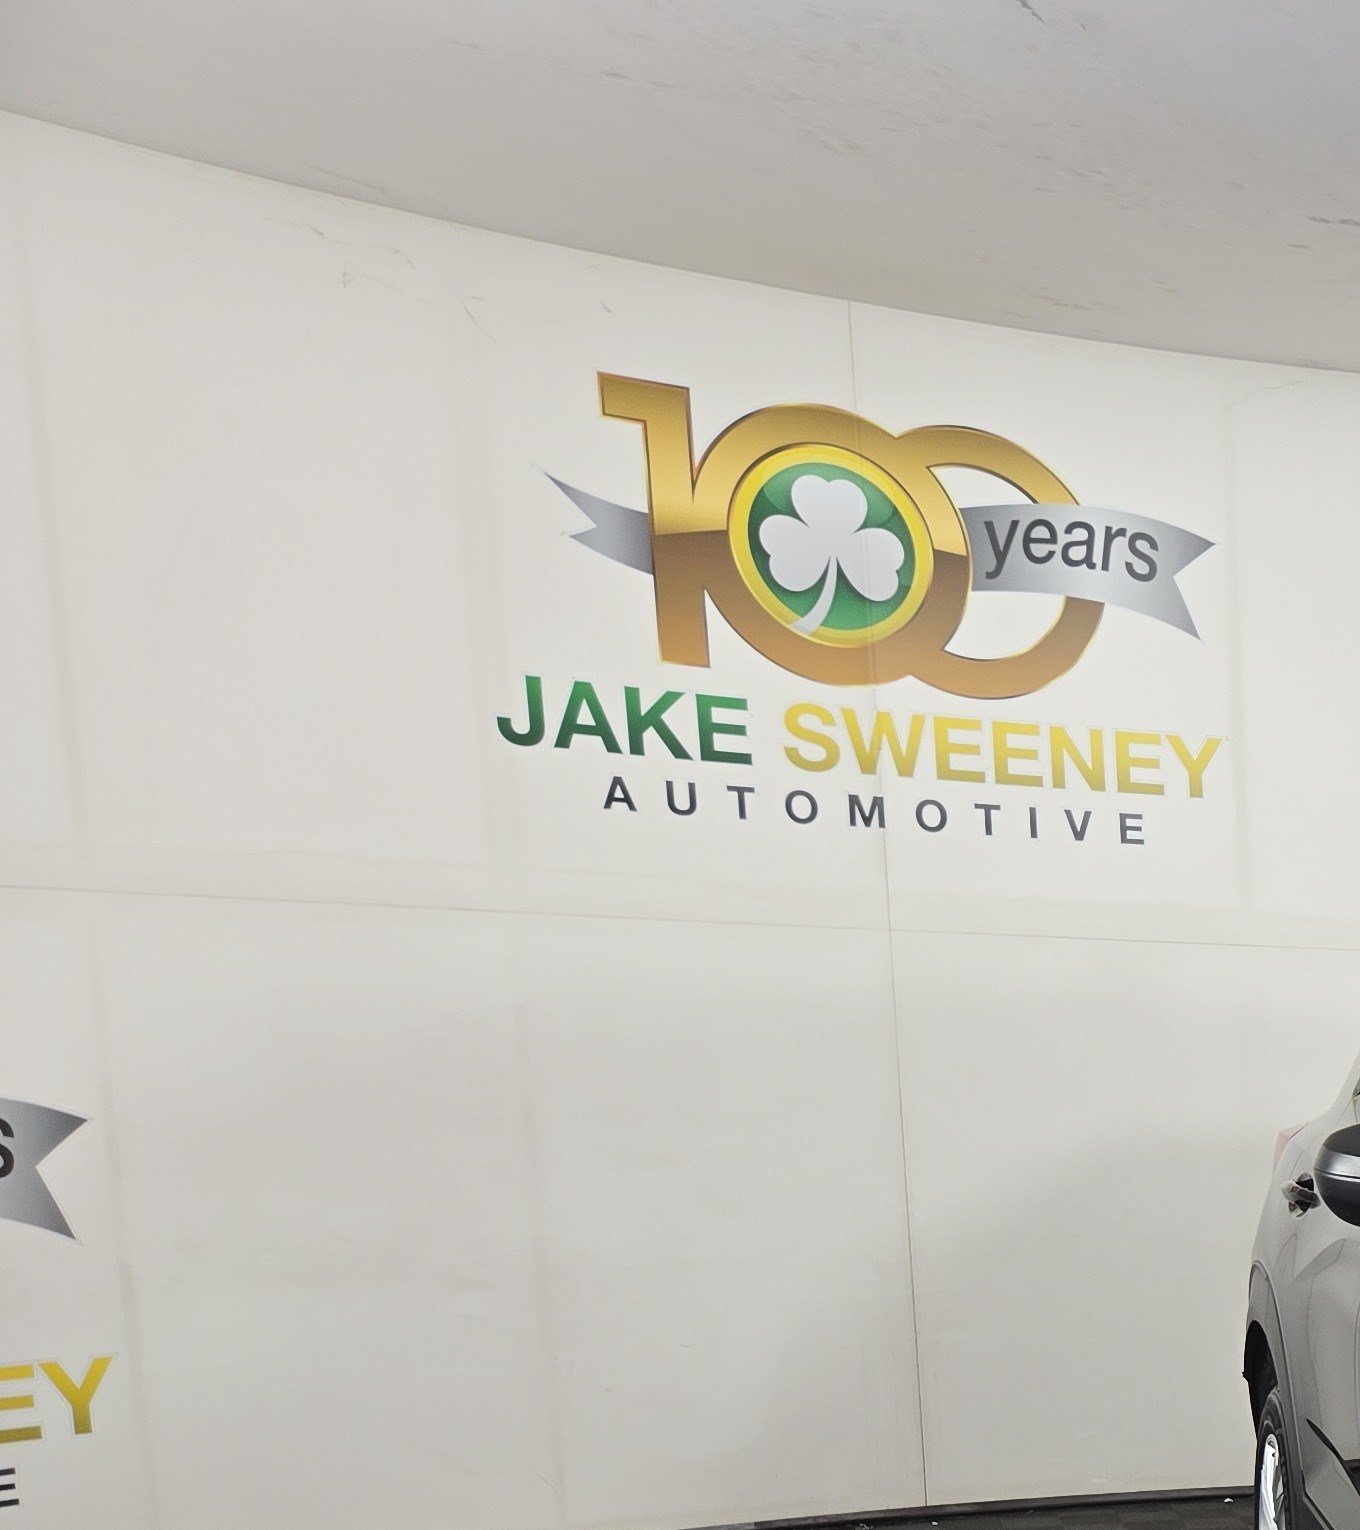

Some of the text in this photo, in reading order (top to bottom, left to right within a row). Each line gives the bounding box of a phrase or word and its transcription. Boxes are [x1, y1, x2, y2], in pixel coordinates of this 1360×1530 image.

[983, 515, 1160, 583] years
[496, 675, 1223, 799] JAKE SWEENEY
[603, 776, 1146, 846] AUTOMOTIVE
